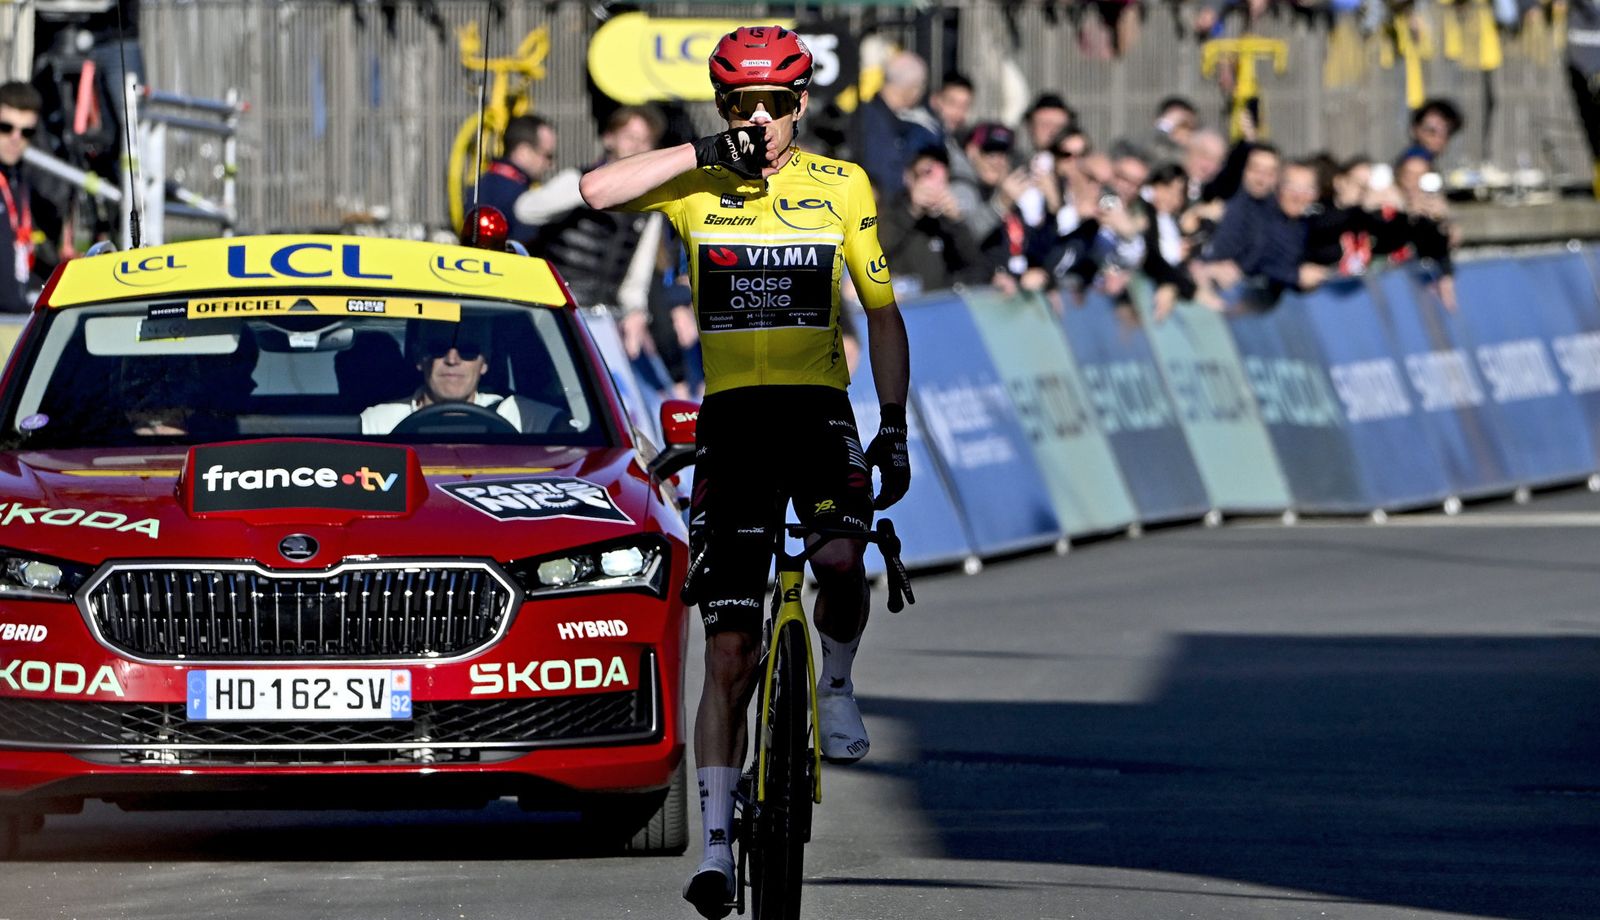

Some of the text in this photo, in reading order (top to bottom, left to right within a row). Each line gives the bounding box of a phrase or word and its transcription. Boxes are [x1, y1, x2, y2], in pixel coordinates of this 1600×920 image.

[723, 133, 741, 162] nimbl
[811, 161, 849, 178] LCL
[704, 213, 757, 226] Santini
[121, 255, 187, 274] LCL
[228, 243, 392, 280] LCL
[437, 256, 503, 276] LCL
[746, 247, 818, 266] VISMA
[731, 275, 792, 291] lease
[196, 300, 286, 314] OFFICIEL
[414, 303, 423, 315] 1
[455, 482, 591, 498] PARIS
[475, 490, 611, 512] NICE
[708, 598, 759, 608] cervélo
[557, 619, 629, 640] HYBRID
[469, 656, 629, 695] SKODA
[193, 698, 200, 707] F
[391, 694, 411, 713] 92
